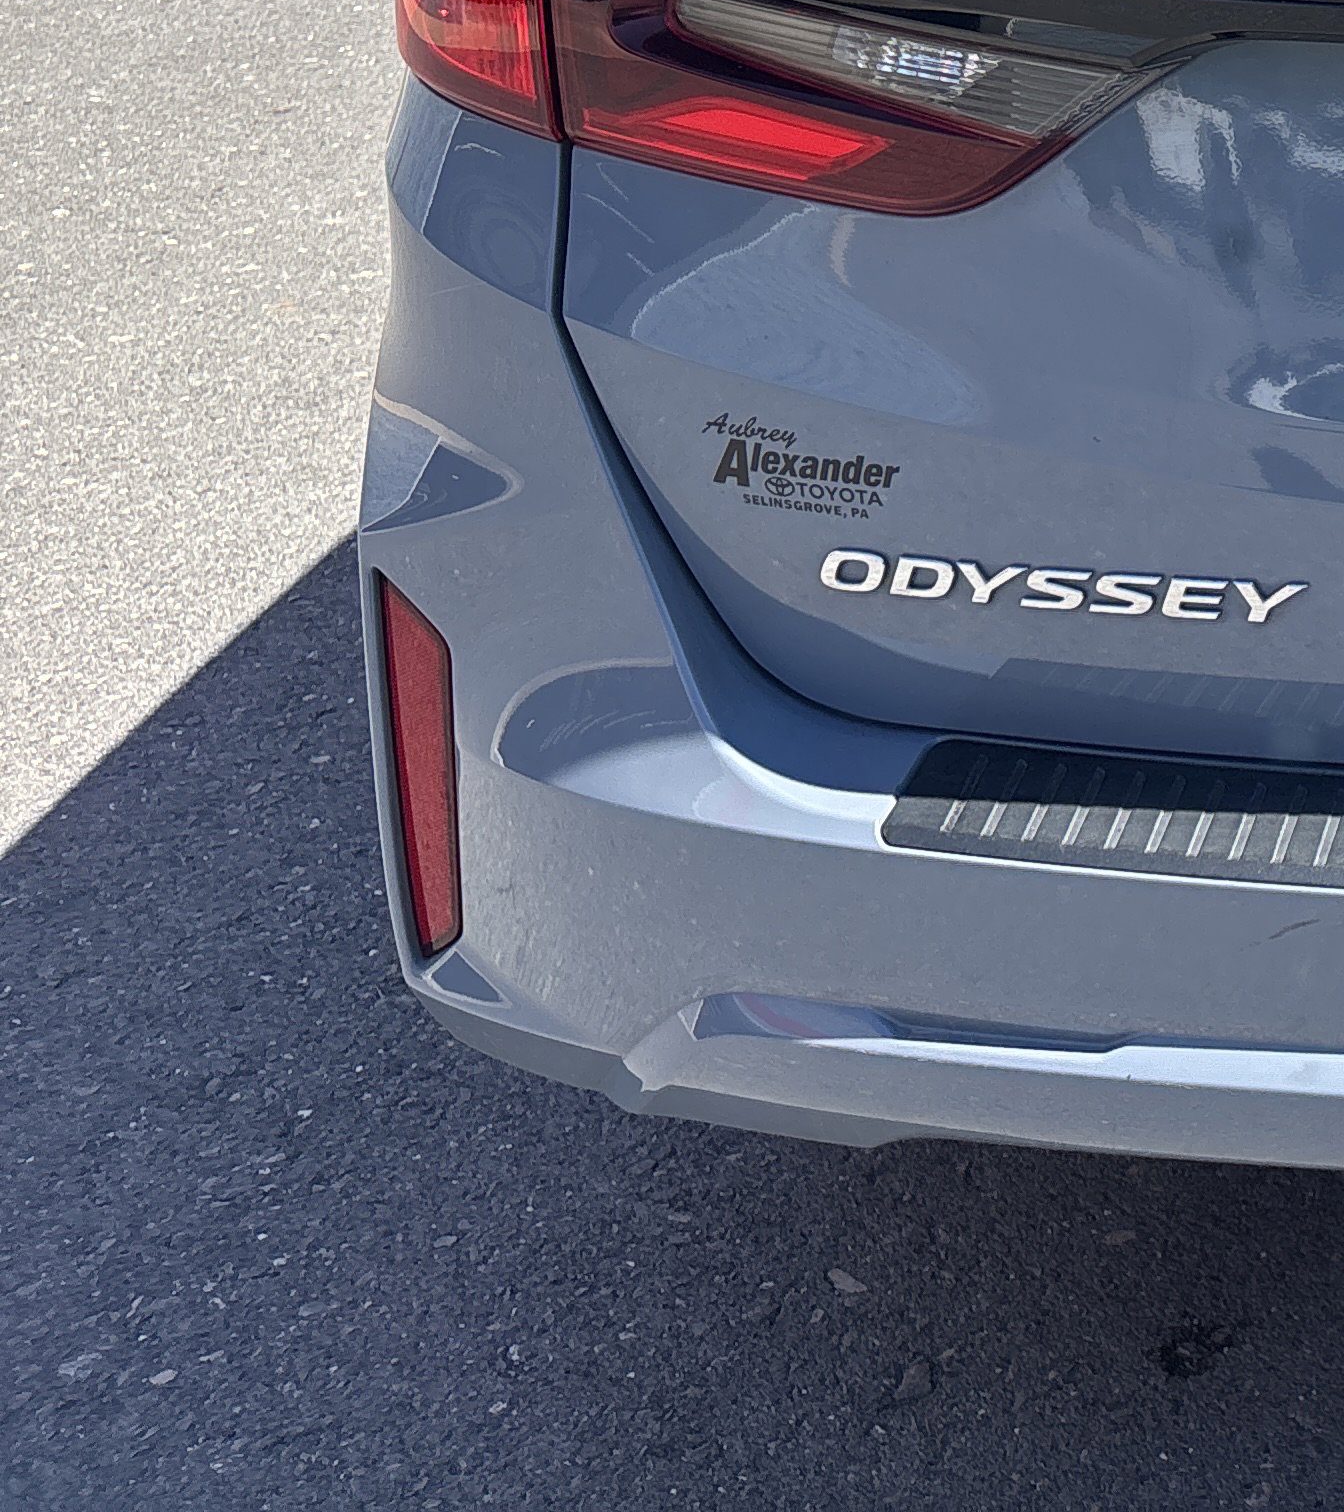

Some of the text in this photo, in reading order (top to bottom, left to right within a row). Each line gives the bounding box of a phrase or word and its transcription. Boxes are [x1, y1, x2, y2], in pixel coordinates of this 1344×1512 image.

[702, 412, 798, 449] Aubrey
[713, 438, 901, 489] Alexander
[742, 493, 870, 520] SELINSGROVE, PA
[795, 482, 884, 507] TOYOTA
[818, 546, 1311, 624] ODYSSEY
